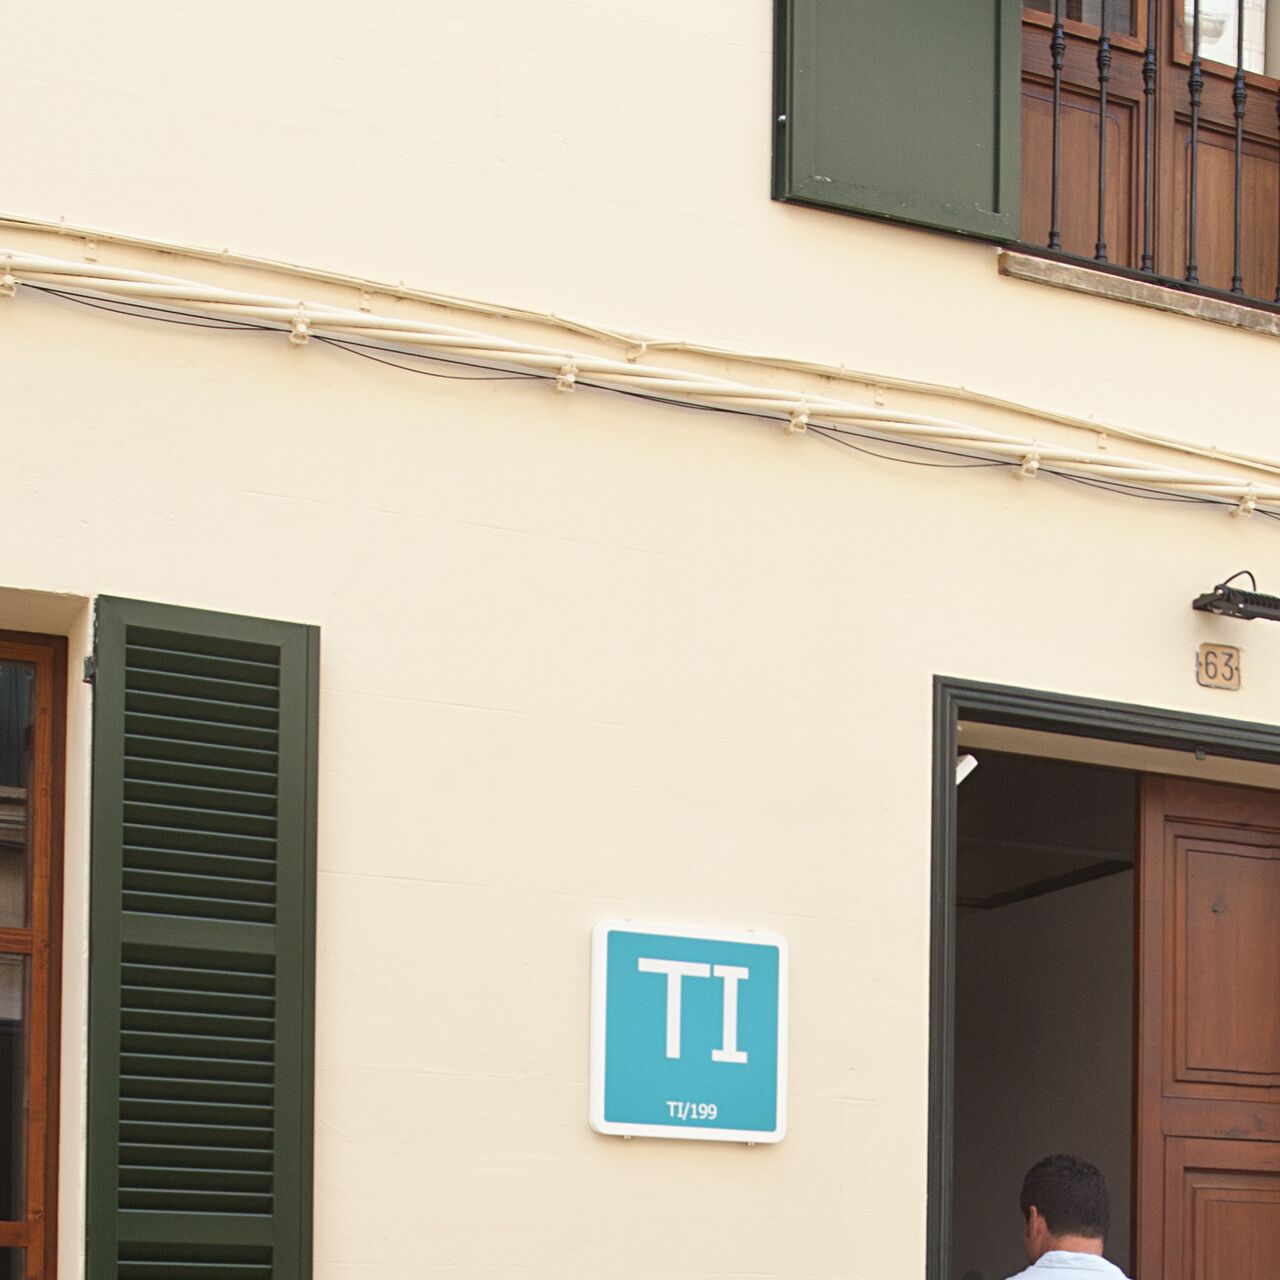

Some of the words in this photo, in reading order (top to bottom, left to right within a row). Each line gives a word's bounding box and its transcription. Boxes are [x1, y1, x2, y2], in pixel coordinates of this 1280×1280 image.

[1205, 650, 1234, 682] 63
[637, 957, 750, 1064] TI
[666, 1100, 718, 1121] TI/199
